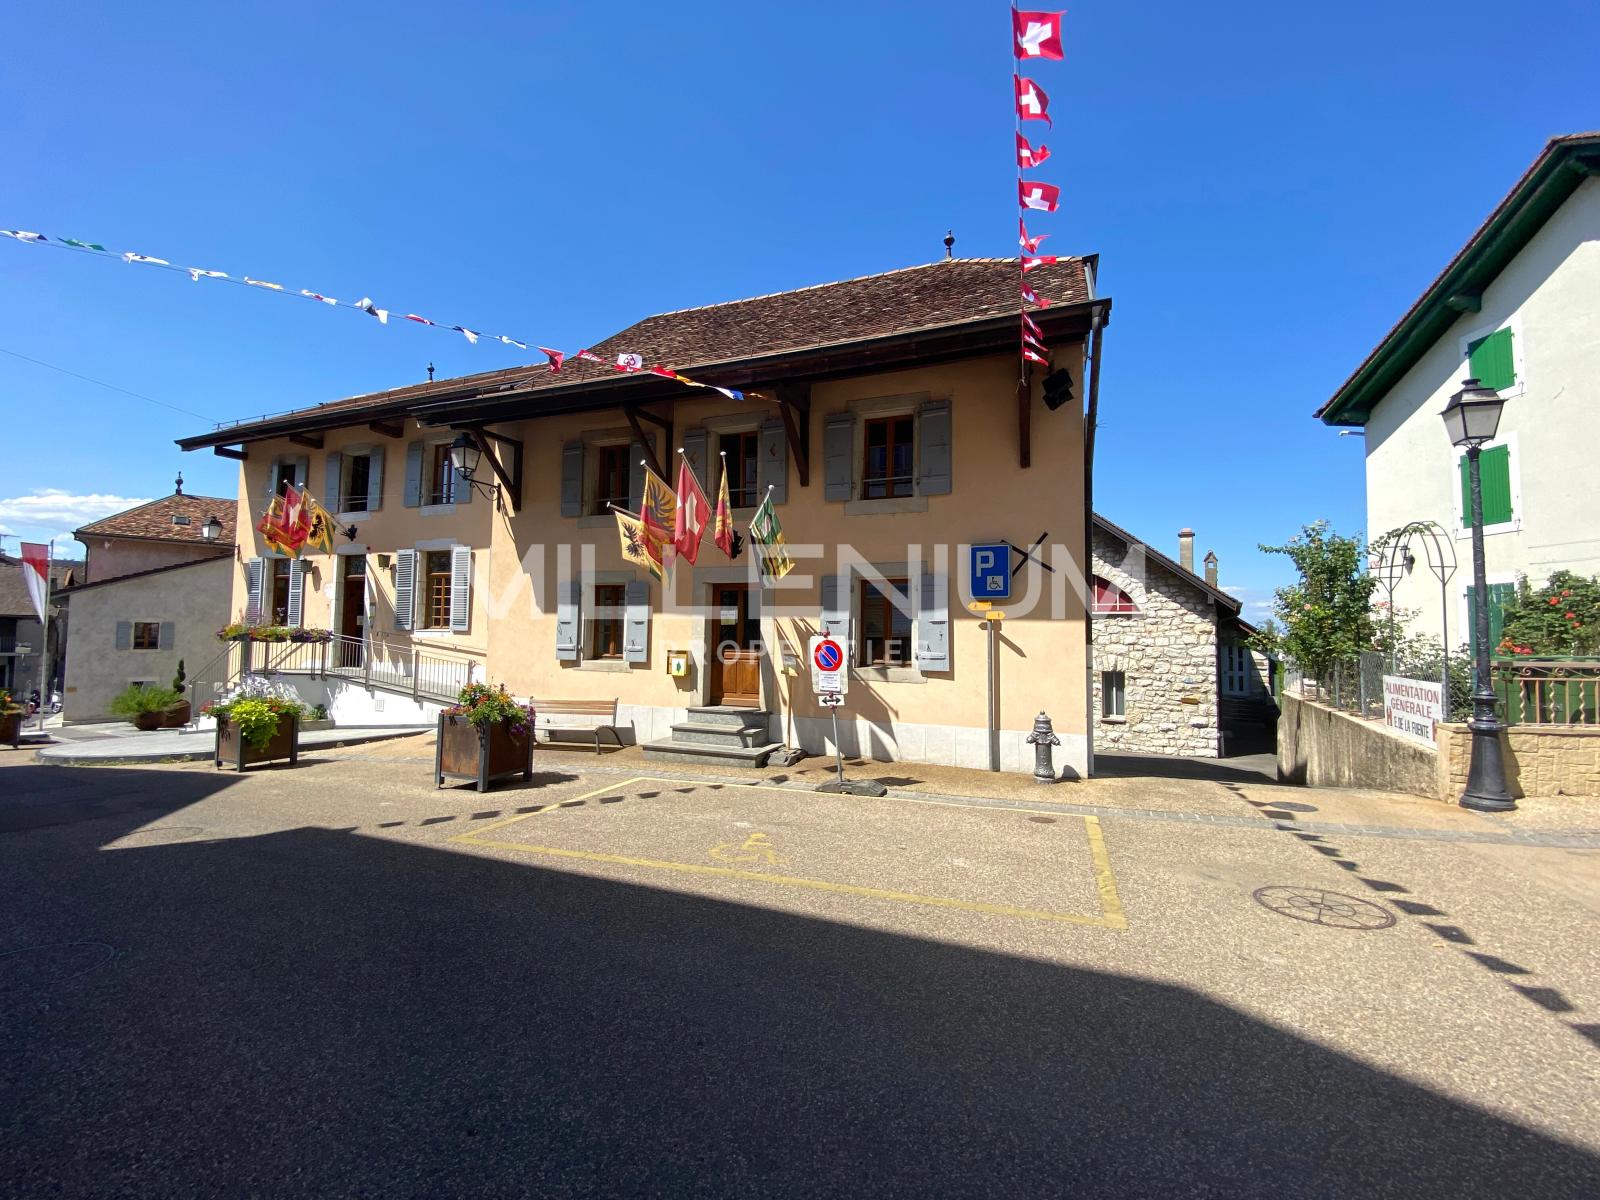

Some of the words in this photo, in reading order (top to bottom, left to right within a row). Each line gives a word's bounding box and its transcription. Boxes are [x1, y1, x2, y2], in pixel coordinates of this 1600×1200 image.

[976, 551, 995, 577] P
[1385, 682, 1439, 704] ALIMENTATION
[1405, 719, 1410, 732] LA
[1412, 721, 1429, 739] FUENTE
